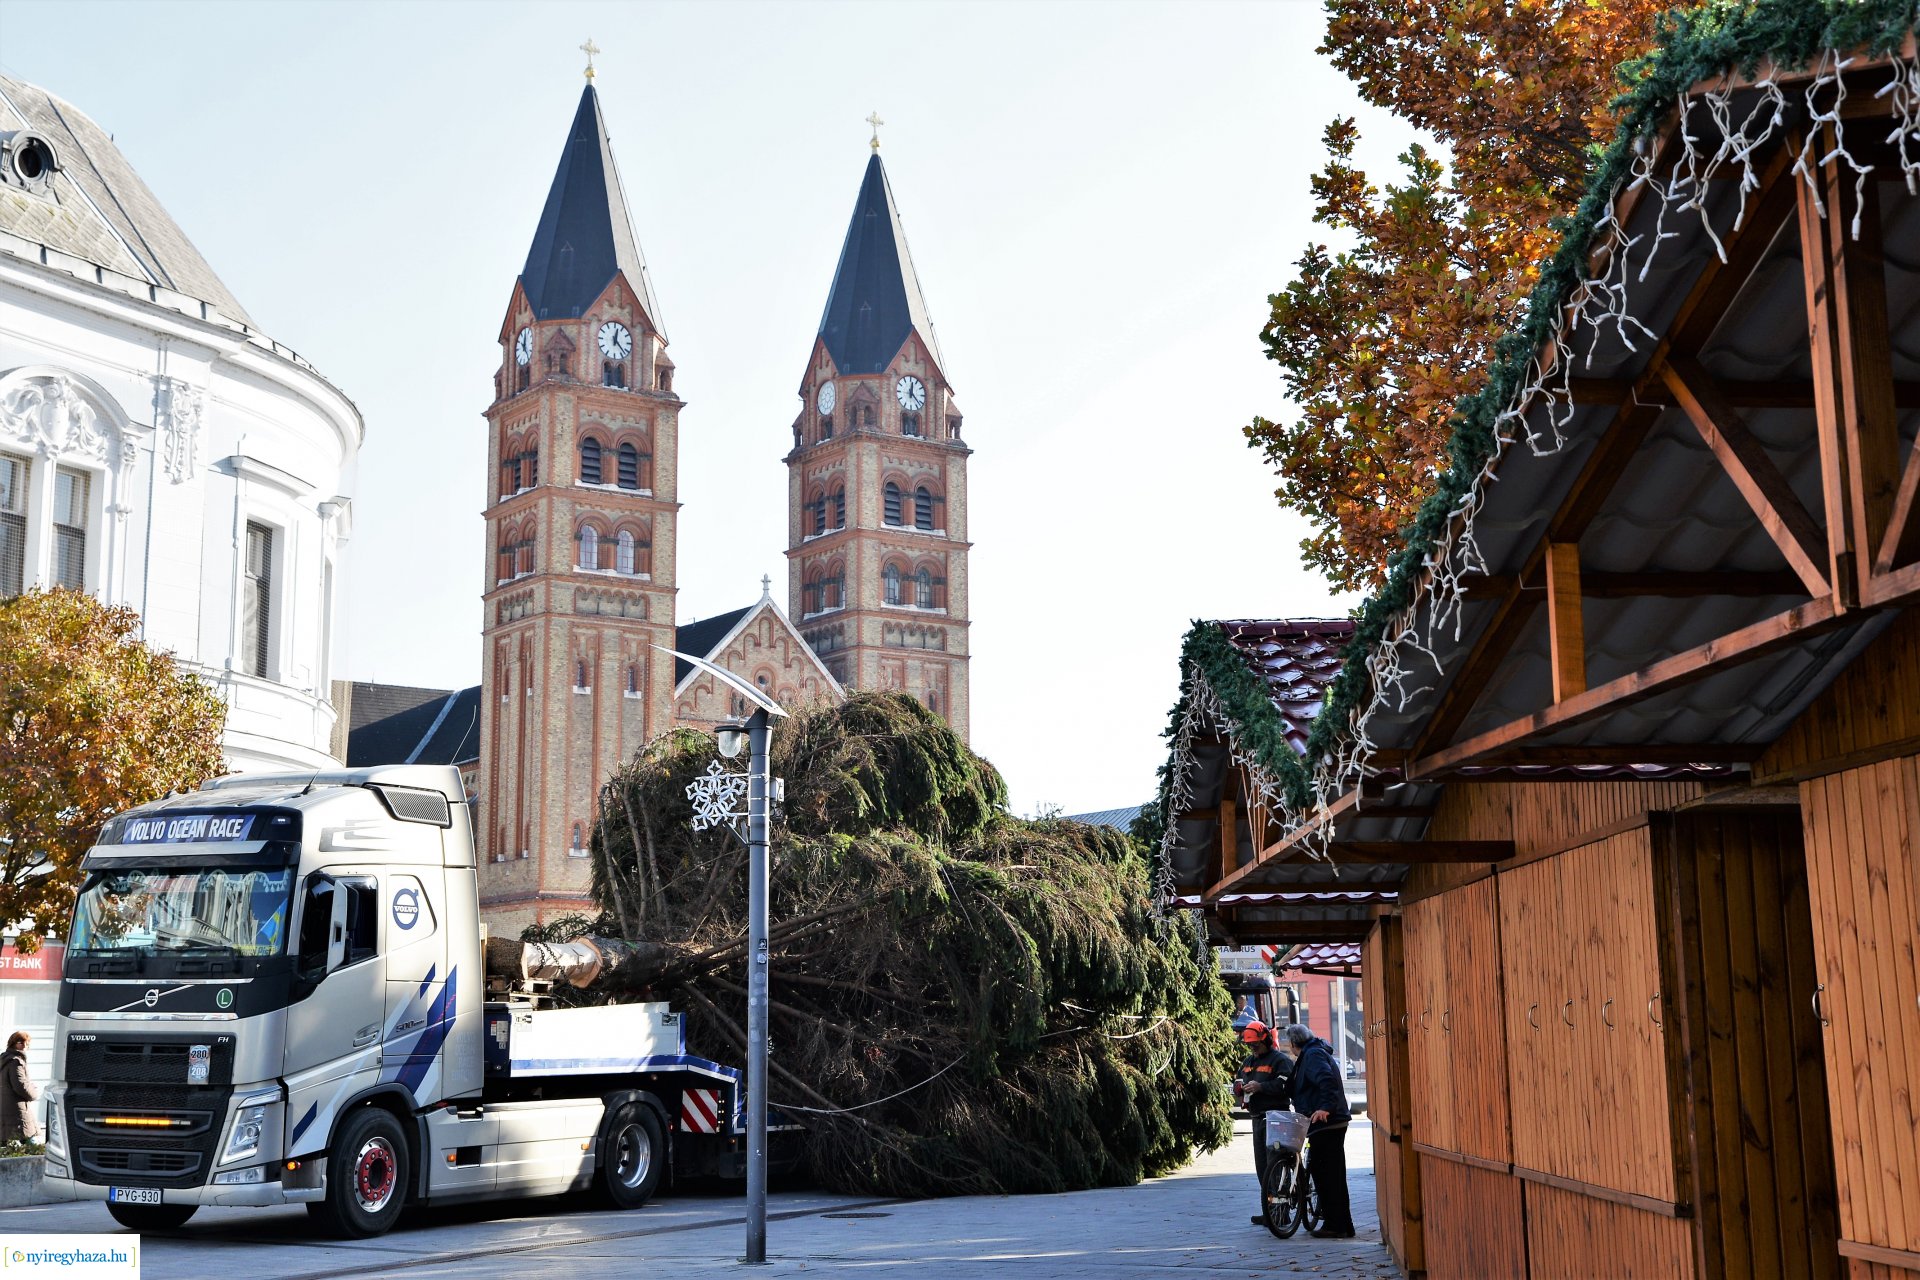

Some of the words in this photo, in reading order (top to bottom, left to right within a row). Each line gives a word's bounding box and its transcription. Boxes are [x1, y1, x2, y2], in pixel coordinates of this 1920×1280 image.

[131, 820, 166, 841] VOLVO
[167, 819, 209, 839] OCEAN
[208, 818, 244, 838] RACE
[393, 905, 418, 913] VOLVO
[70, 1034, 96, 1042] VOLVO
[191, 1067, 206, 1076] 208
[117, 1190, 159, 1202] PYG-930
